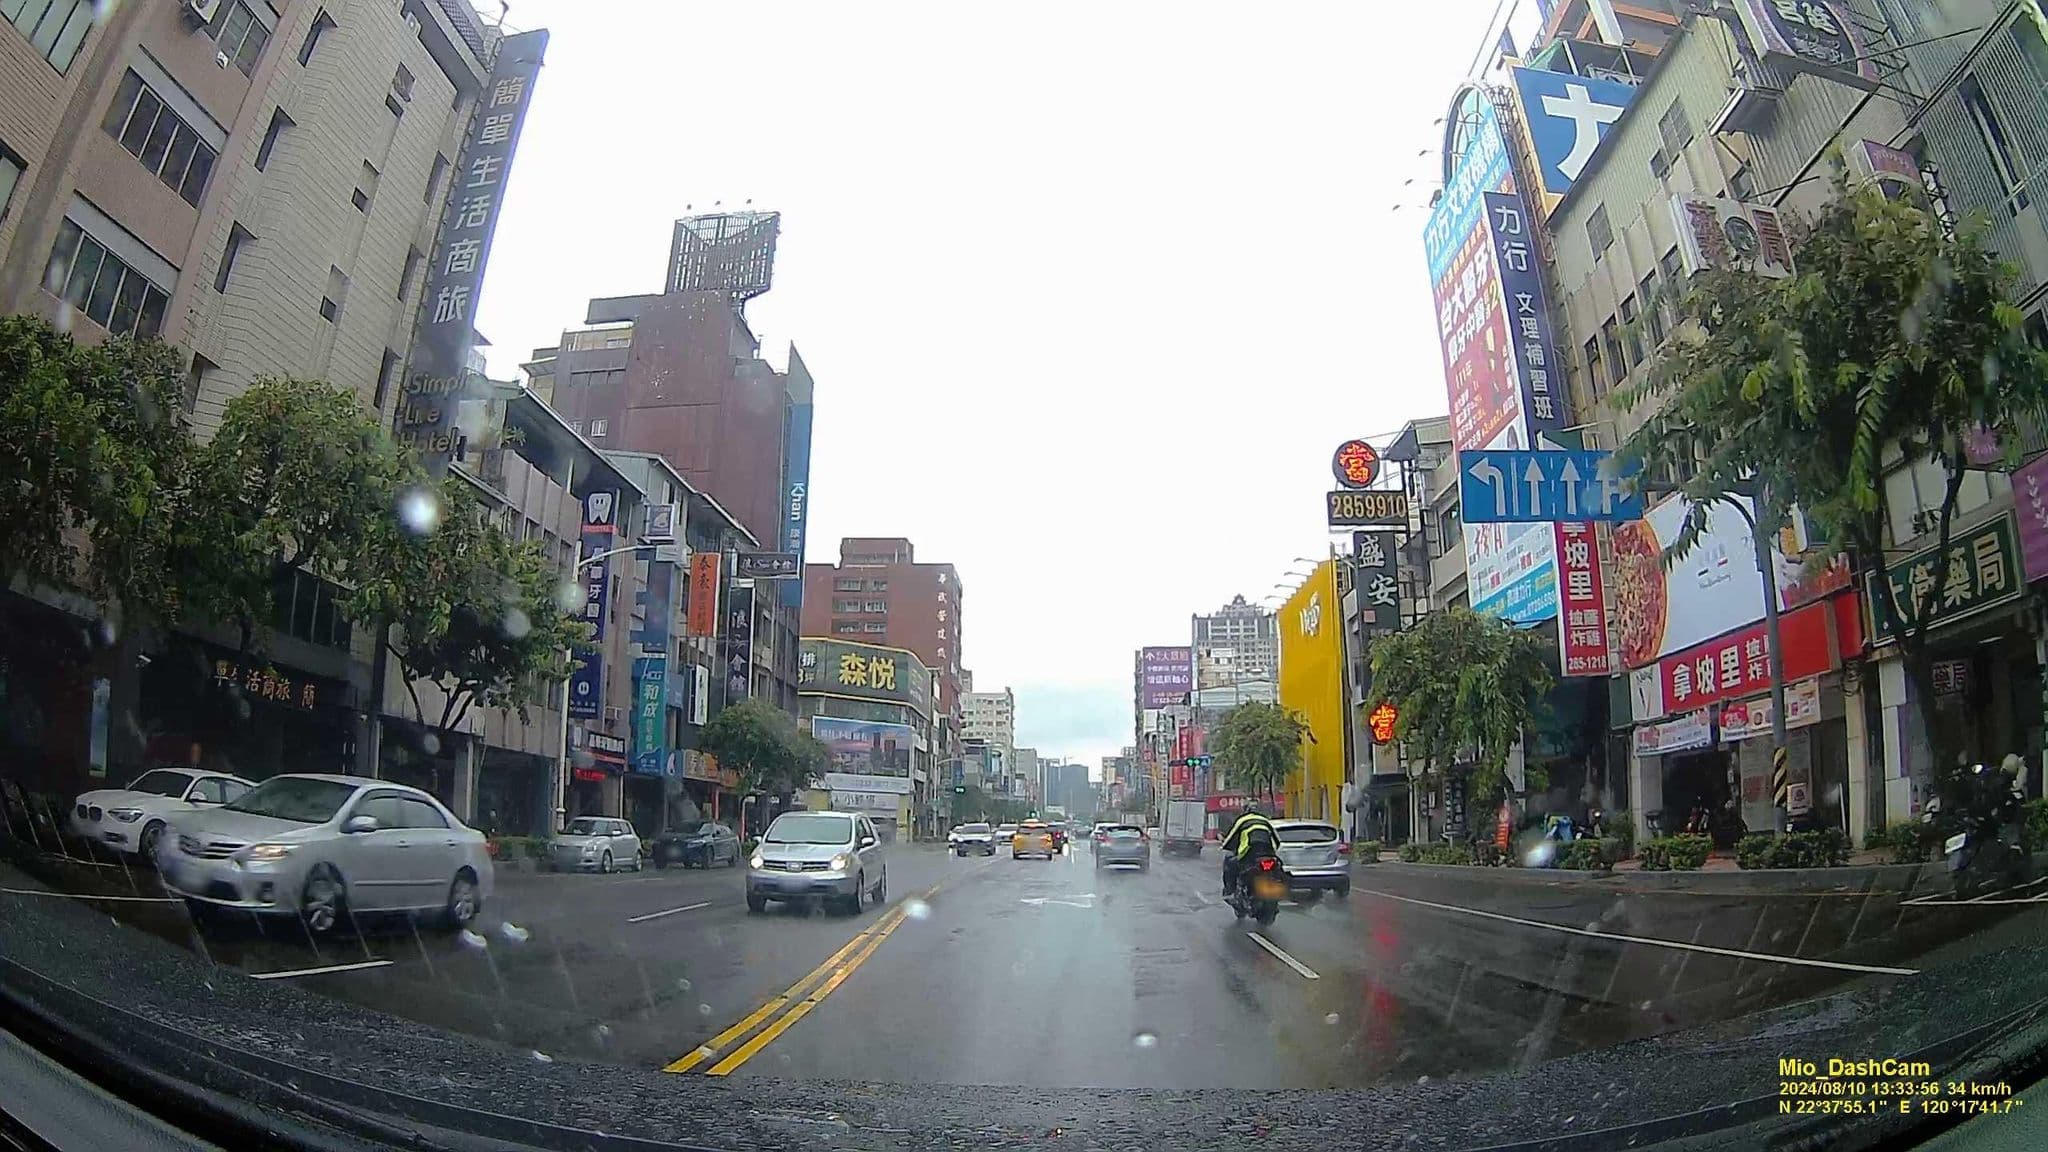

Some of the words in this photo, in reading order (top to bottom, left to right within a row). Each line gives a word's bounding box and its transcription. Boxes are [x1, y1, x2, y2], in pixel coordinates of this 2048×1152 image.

[431, 76, 525, 325] 簡單生活商旅
[1496, 206, 1528, 272] 力行
[1515, 291, 1553, 419] 文理補習班
[404, 403, 440, 424] Lie
[1331, 495, 1407, 518] 2859910
[1358, 534, 1398, 606] 盛安
[1571, 630, 1601, 647] 炸雞
[1672, 645, 1742, 702] 拿坡里
